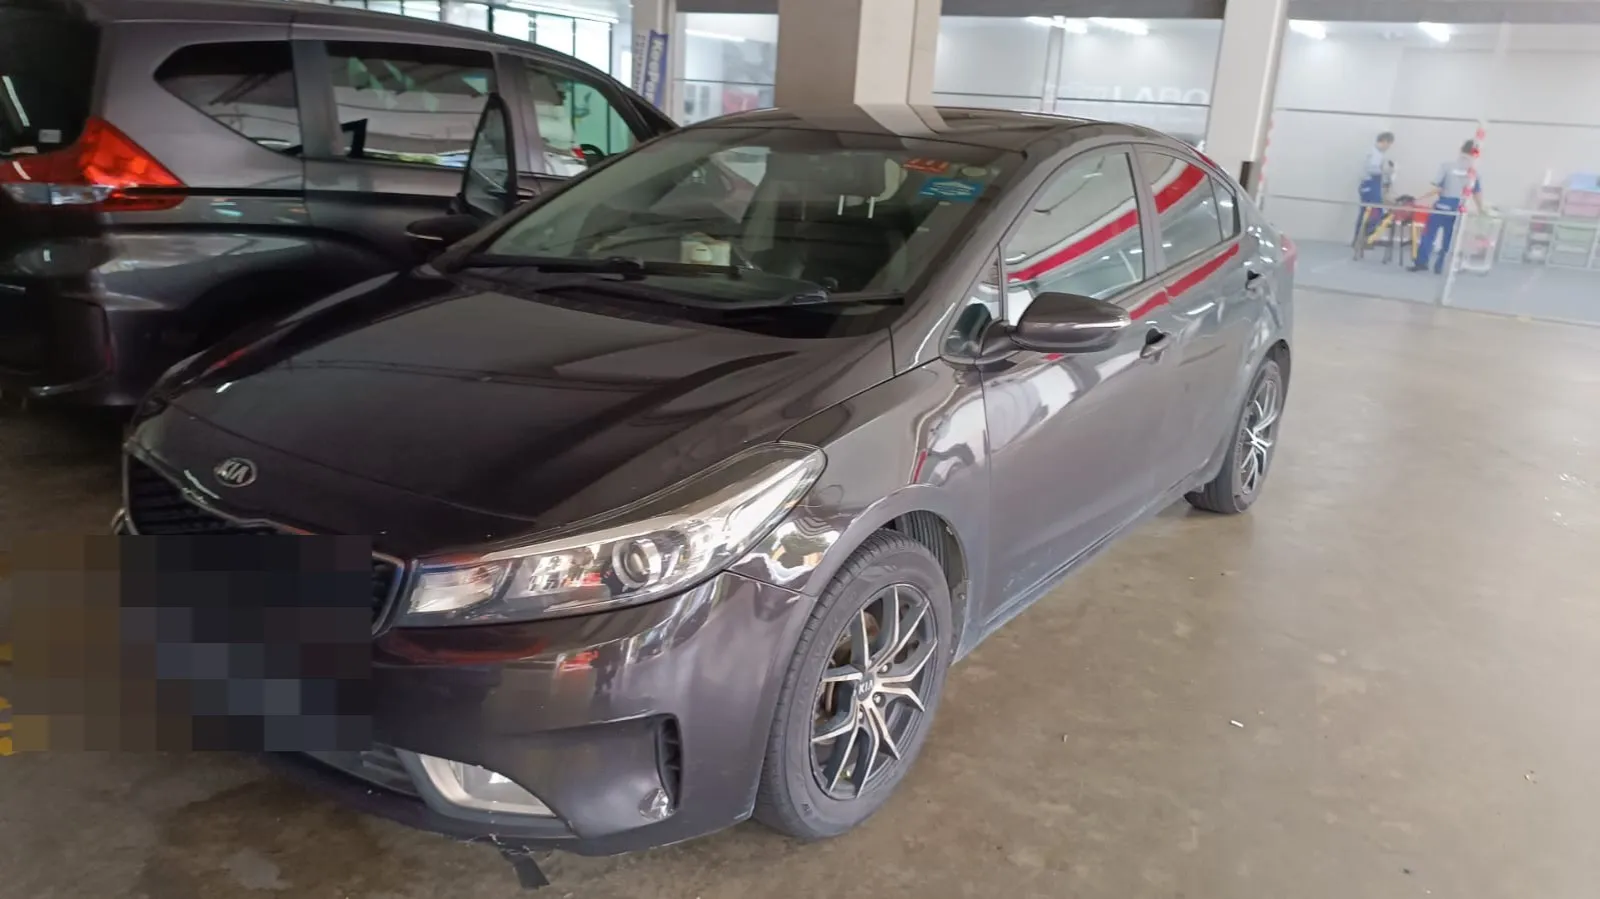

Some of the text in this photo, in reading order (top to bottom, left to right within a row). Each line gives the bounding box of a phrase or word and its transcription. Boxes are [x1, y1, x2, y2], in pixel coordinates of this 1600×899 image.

[1113, 85, 1209, 108] LABO
[215, 459, 252, 485] KIA
[858, 679, 873, 695] KIA
